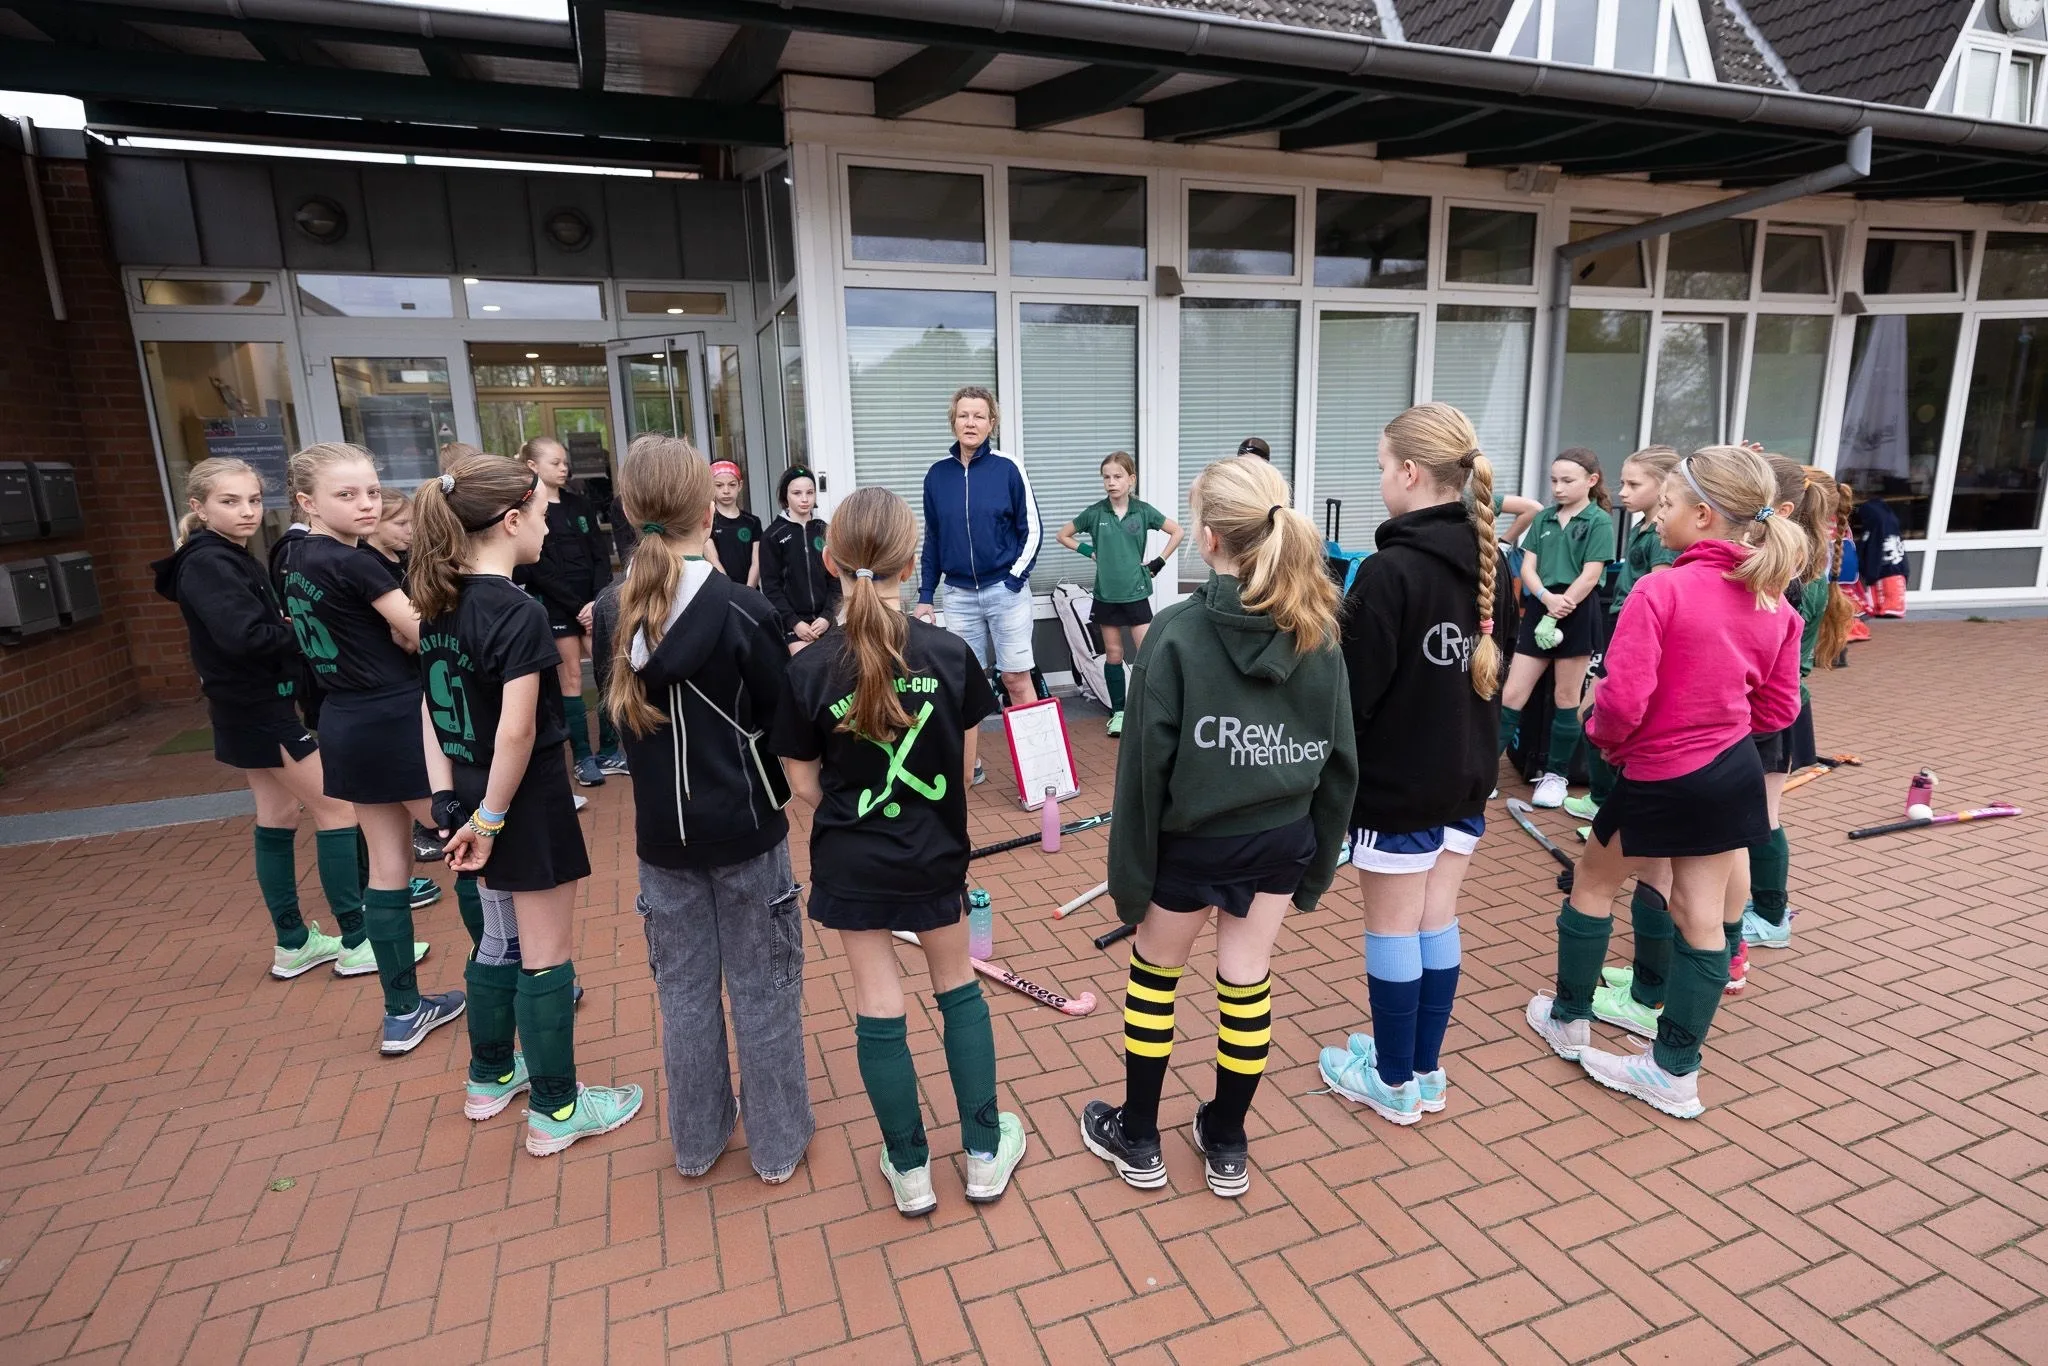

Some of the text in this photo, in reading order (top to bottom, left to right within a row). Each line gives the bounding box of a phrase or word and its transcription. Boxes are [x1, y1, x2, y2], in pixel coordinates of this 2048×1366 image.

[1194, 716, 1285, 749] CRew
[1230, 737, 1329, 766] member
[1015, 978, 1068, 1008] Reece
